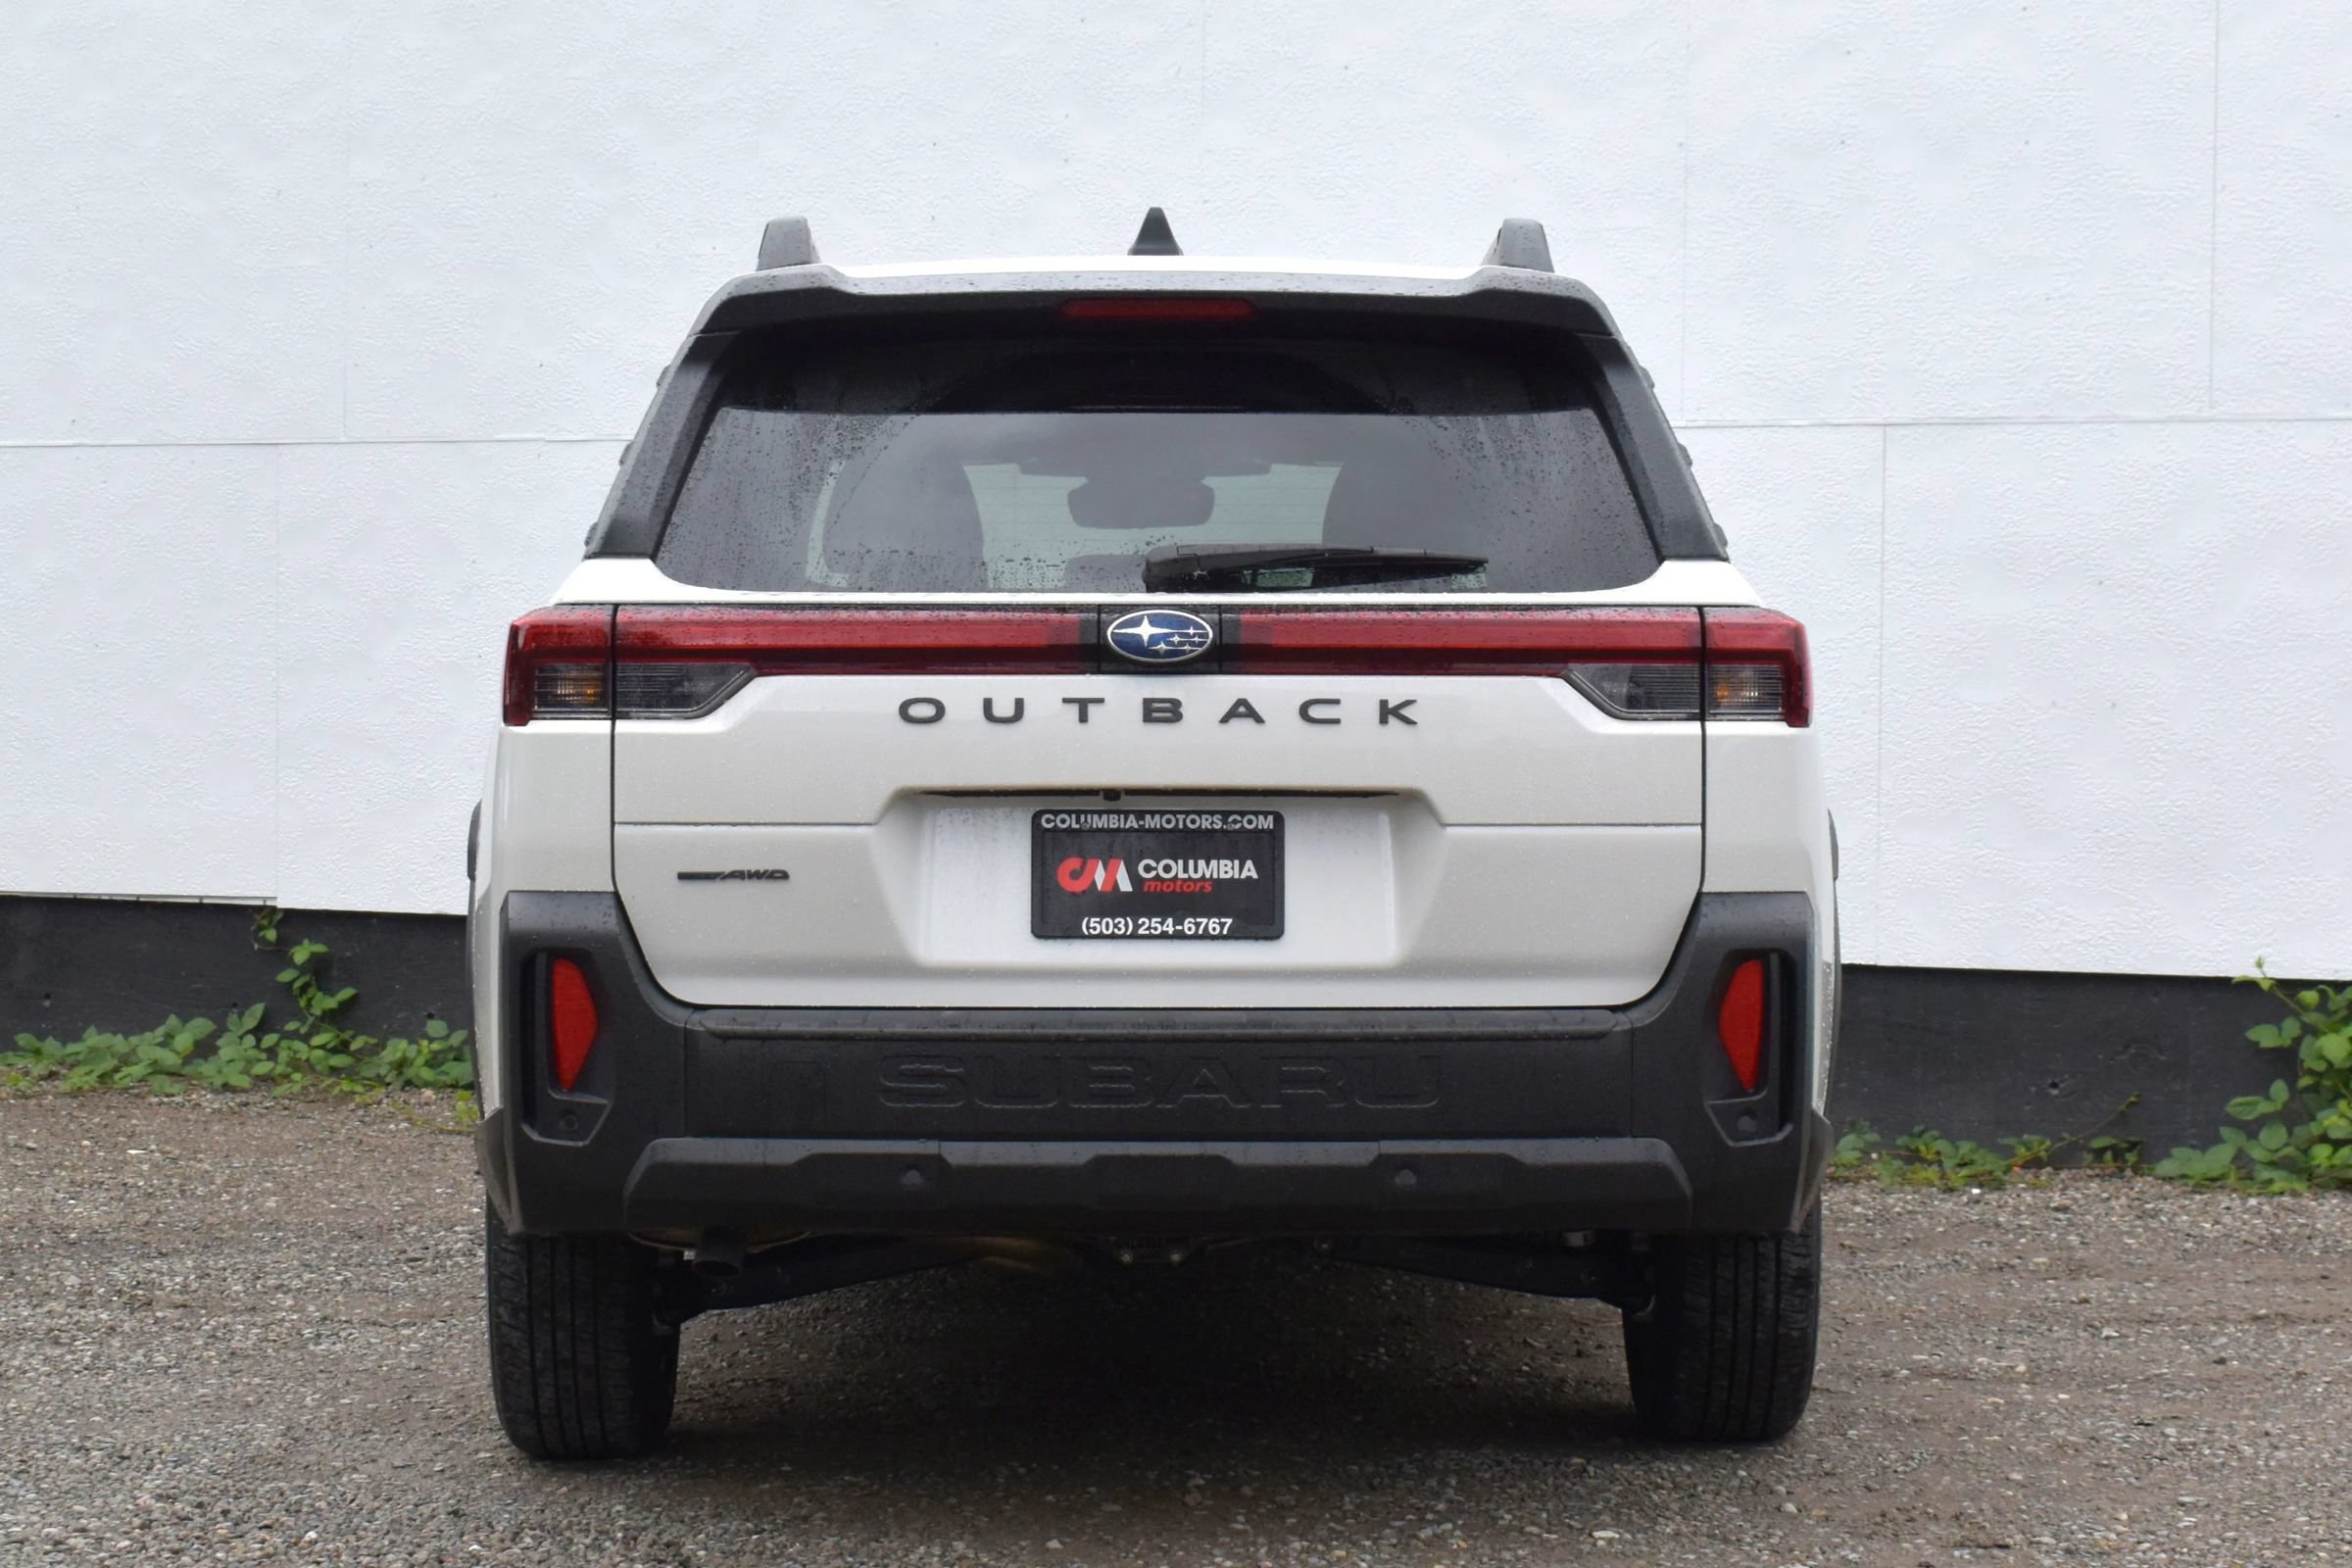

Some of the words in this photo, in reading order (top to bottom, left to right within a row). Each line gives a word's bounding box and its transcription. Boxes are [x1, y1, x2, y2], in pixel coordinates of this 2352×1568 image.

[899, 697, 1417, 725] OUTBACK
[1041, 814, 1274, 829] COLUMBIA-MOTORS.COM
[1137, 858, 1258, 879] COLUMBIA
[1143, 881, 1213, 894] motors
[1082, 917, 1133, 935] (503)
[1138, 918, 1233, 935] 254-6767
[879, 1054, 1441, 1108] SUBARU
